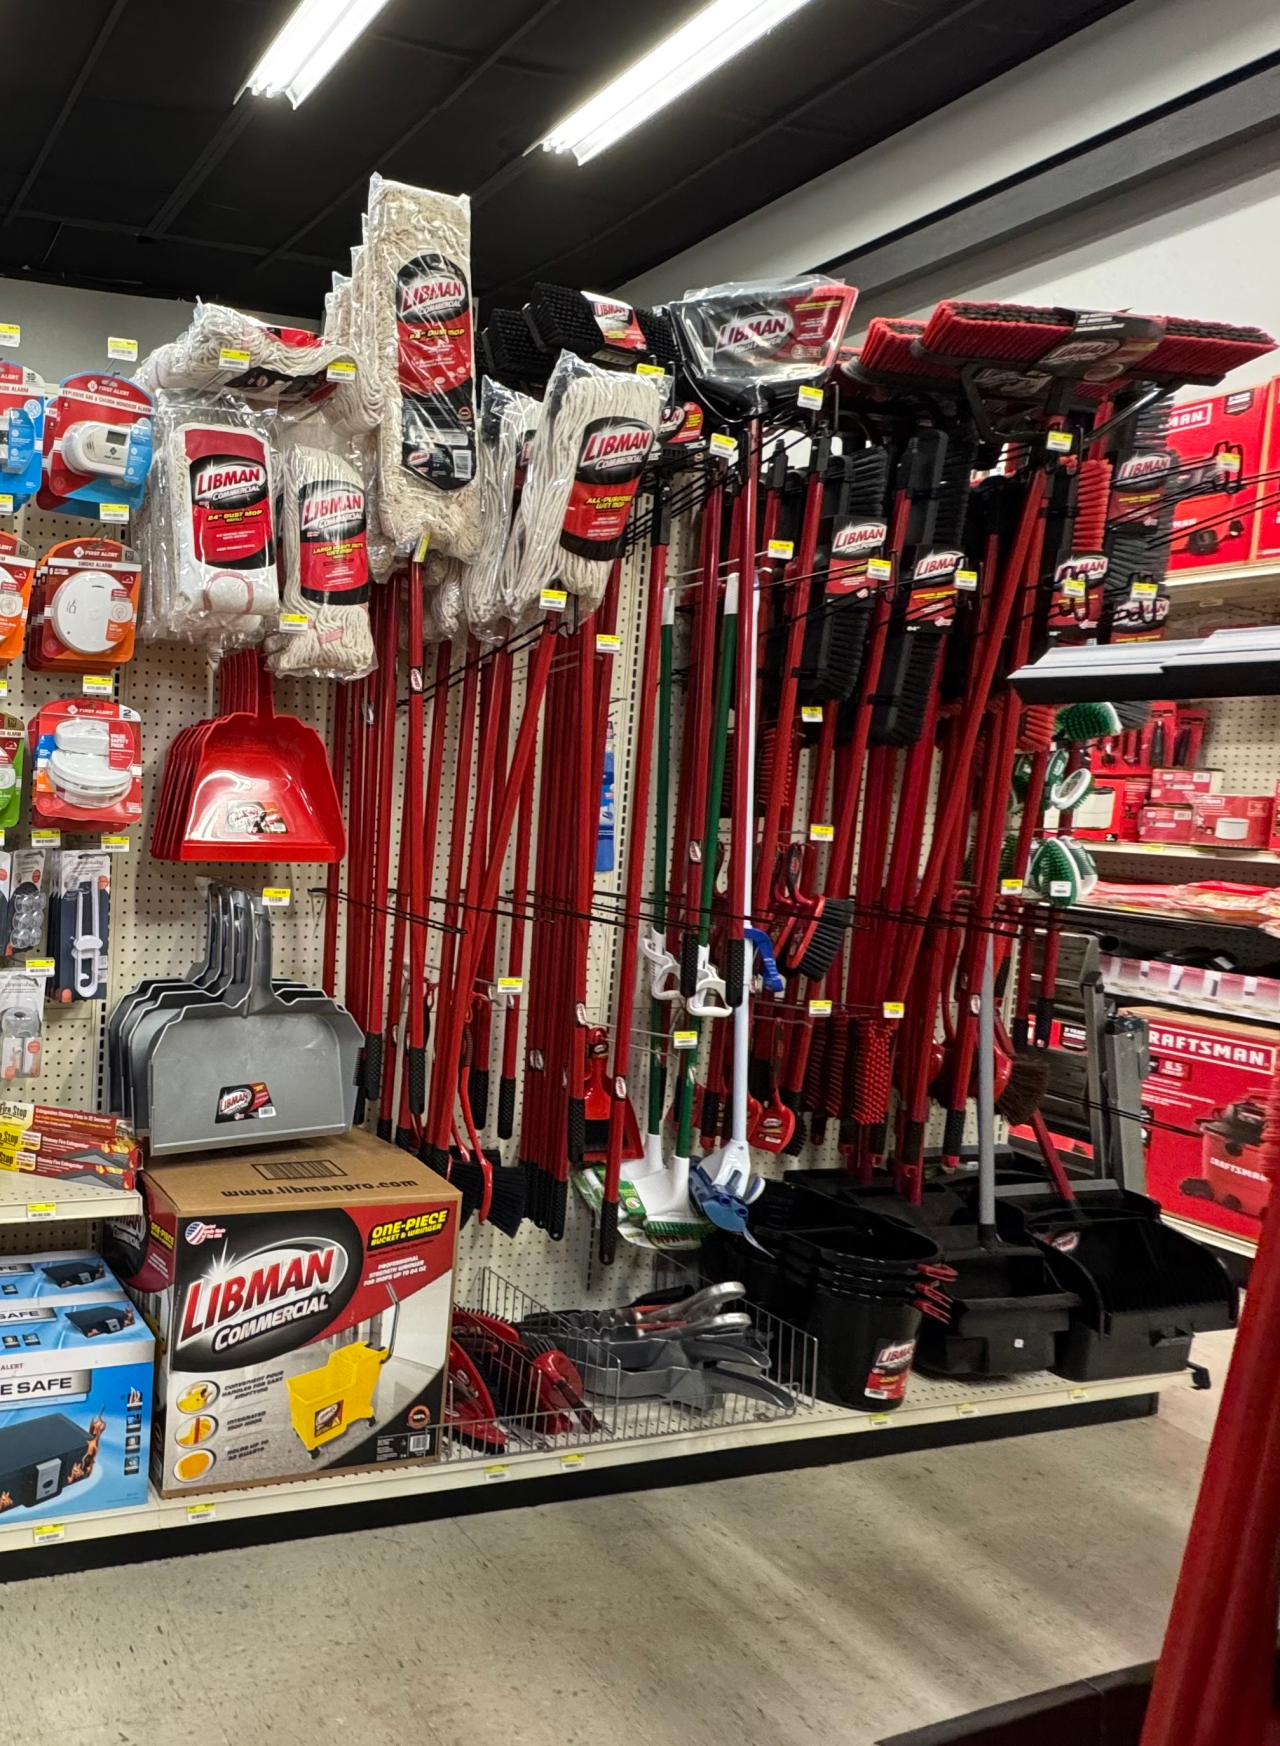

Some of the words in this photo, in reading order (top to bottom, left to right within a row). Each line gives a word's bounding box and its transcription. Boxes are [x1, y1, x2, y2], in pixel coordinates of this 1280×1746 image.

[402, 282, 462, 312] LIBMAN
[594, 301, 626, 318] LIBMAN
[717, 317, 787, 349] LIBMAN
[583, 432, 651, 462] LIBMAN
[1121, 457, 1170, 478] LIBMAN
[197, 469, 260, 496] LIBMAN
[213, 485, 260, 501] COMMERCIAL
[586, 495, 632, 504] ALL-PURPOSE
[303, 495, 362, 527] LIBMAN
[835, 528, 885, 548] LIBMAN
[1149, 1030, 1264, 1066] RAFTSMAN
[0, 1102, 11, 1114] Fire
[13, 1106, 27, 1119] Stop
[4, 1132, 18, 1144] Stop
[0, 1152, 13, 1164] Stop
[221, 1178, 419, 1197] www.libmanpro.com
[372, 1210, 448, 1238] ONE-PIECE
[371, 1234, 399, 1246] BUCKET
[408, 1224, 442, 1237] WRINGER
[179, 1246, 338, 1345] LIBMAN
[215, 1293, 329, 1351] COMMERCIAL
[3, 1363, 23, 1371] ALERT
[17, 1377, 72, 1393] SAFE
